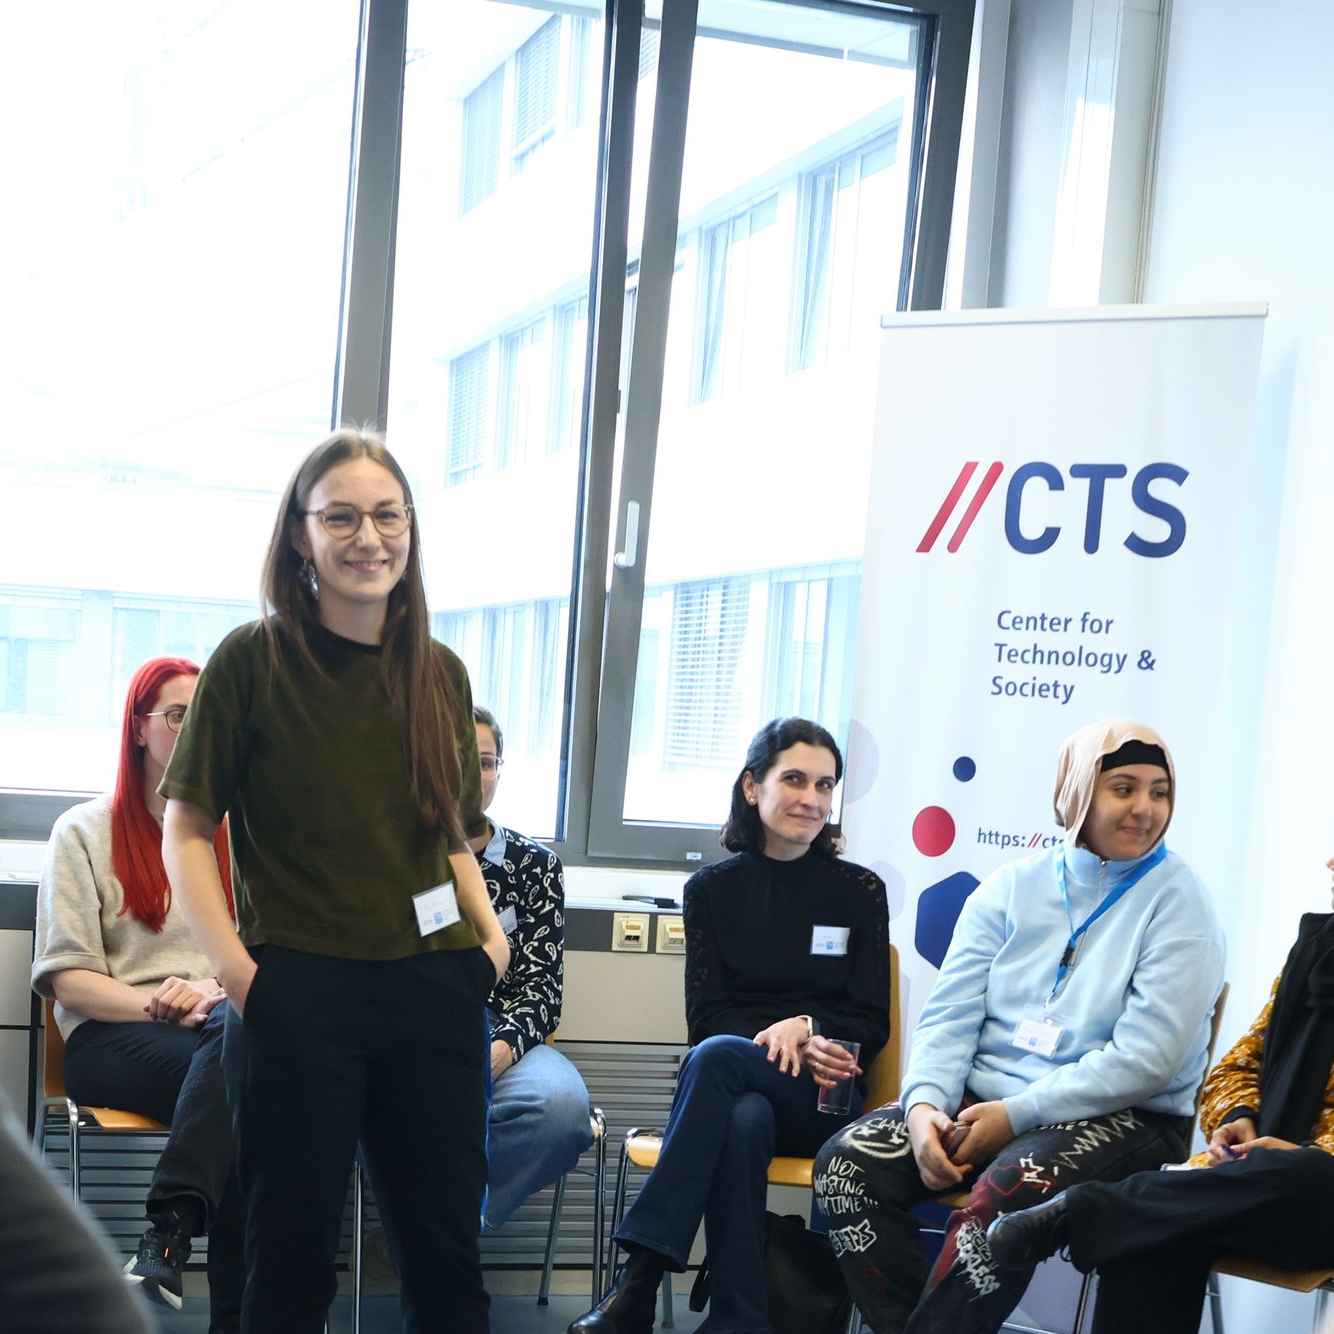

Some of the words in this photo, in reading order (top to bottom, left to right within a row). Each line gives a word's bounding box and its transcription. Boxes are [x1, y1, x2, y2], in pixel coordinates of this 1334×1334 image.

[996, 609, 1073, 633] Center
[1080, 611, 1114, 635] for
[994, 642, 1128, 675] Technology
[1137, 649, 1157, 671] &
[990, 675, 1075, 705] Society
[827, 1155, 866, 1178] NOT
[813, 1173, 866, 1196] WASTING
